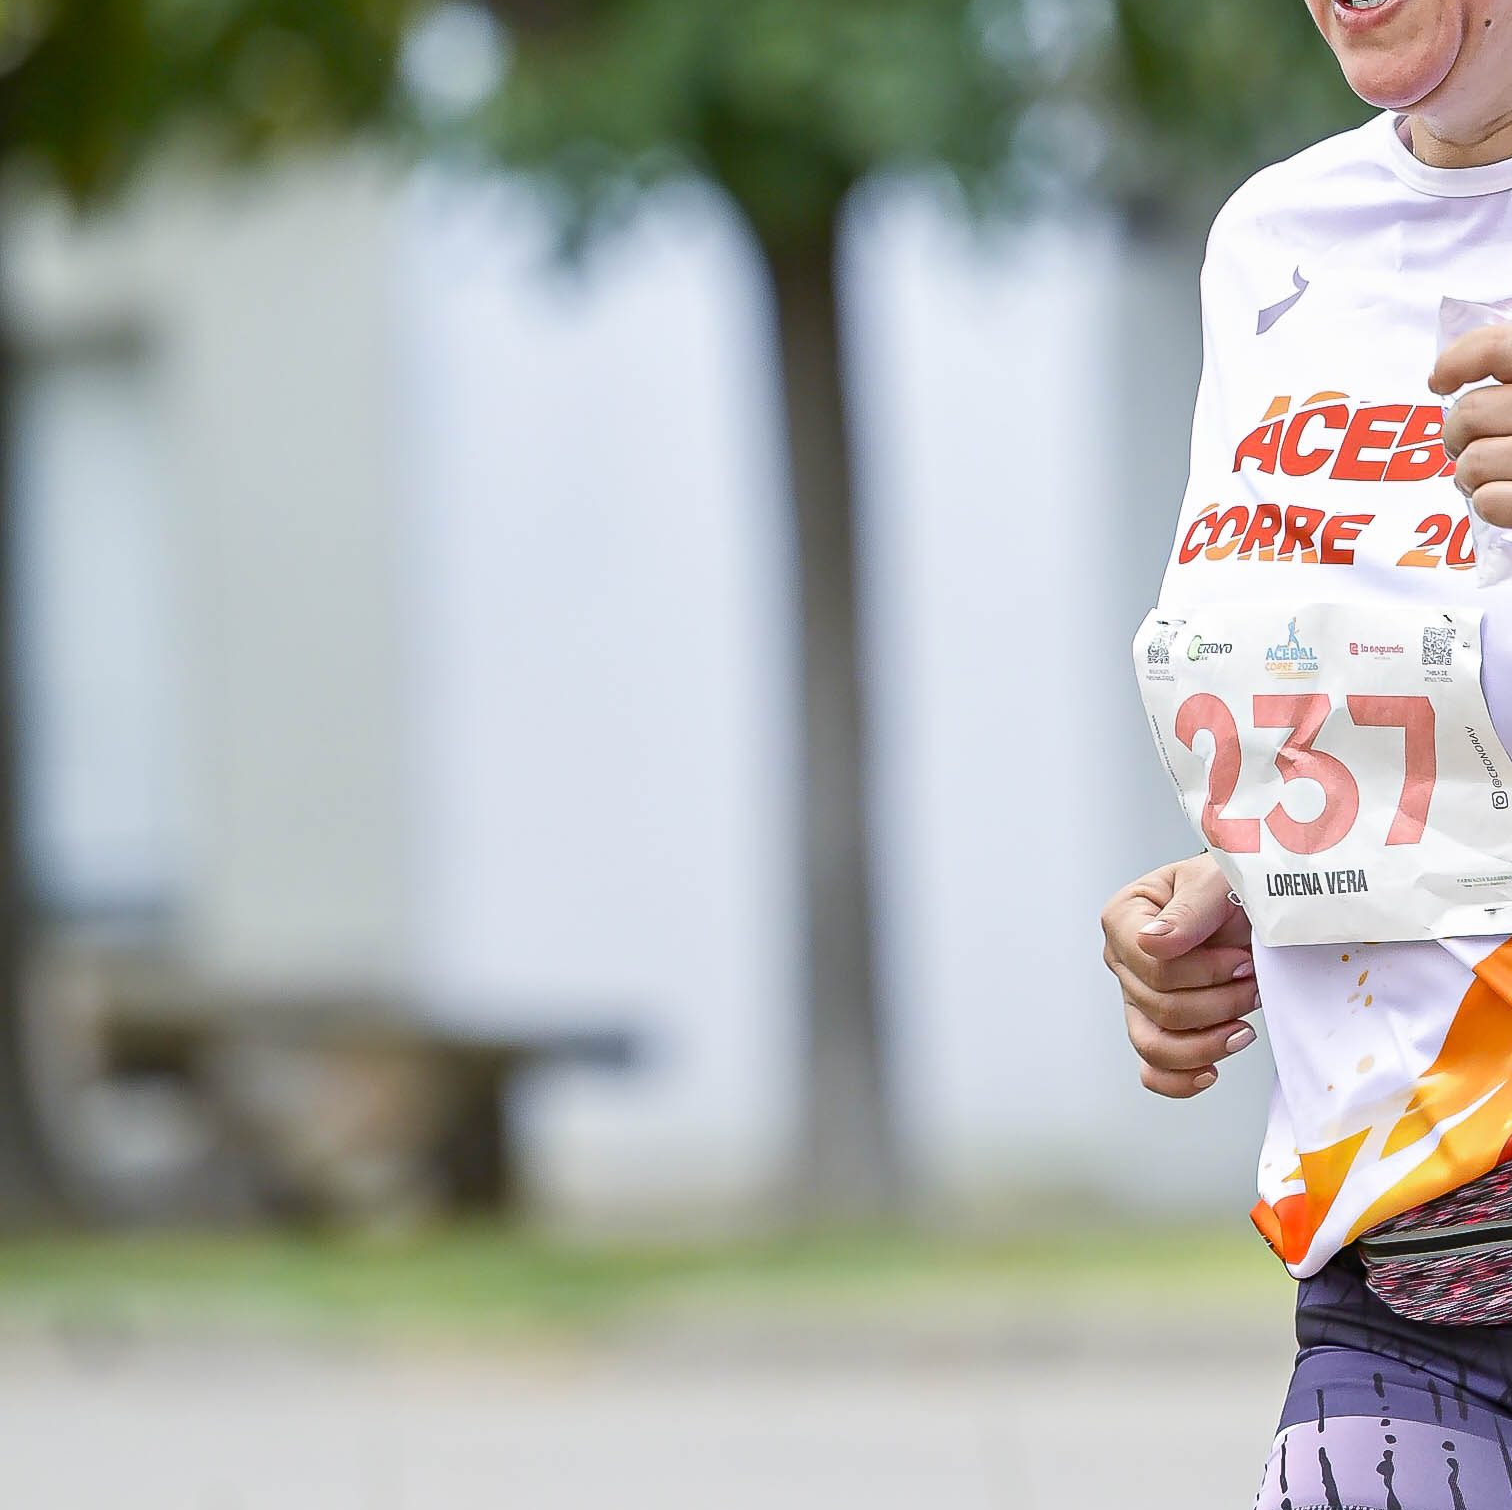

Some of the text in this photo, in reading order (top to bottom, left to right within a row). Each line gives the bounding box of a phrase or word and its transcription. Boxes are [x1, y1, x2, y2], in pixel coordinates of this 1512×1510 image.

[1233, 391, 1457, 481] ACEB
[1179, 503, 1376, 566] CORRE
[1265, 645, 1318, 661] ACEBAL
[1297, 662, 1319, 671] 2026
[1175, 692, 1437, 855] 237
[1464, 725, 1503, 789] @CRONORAV
[1266, 869, 1369, 897] LORENA VERA
